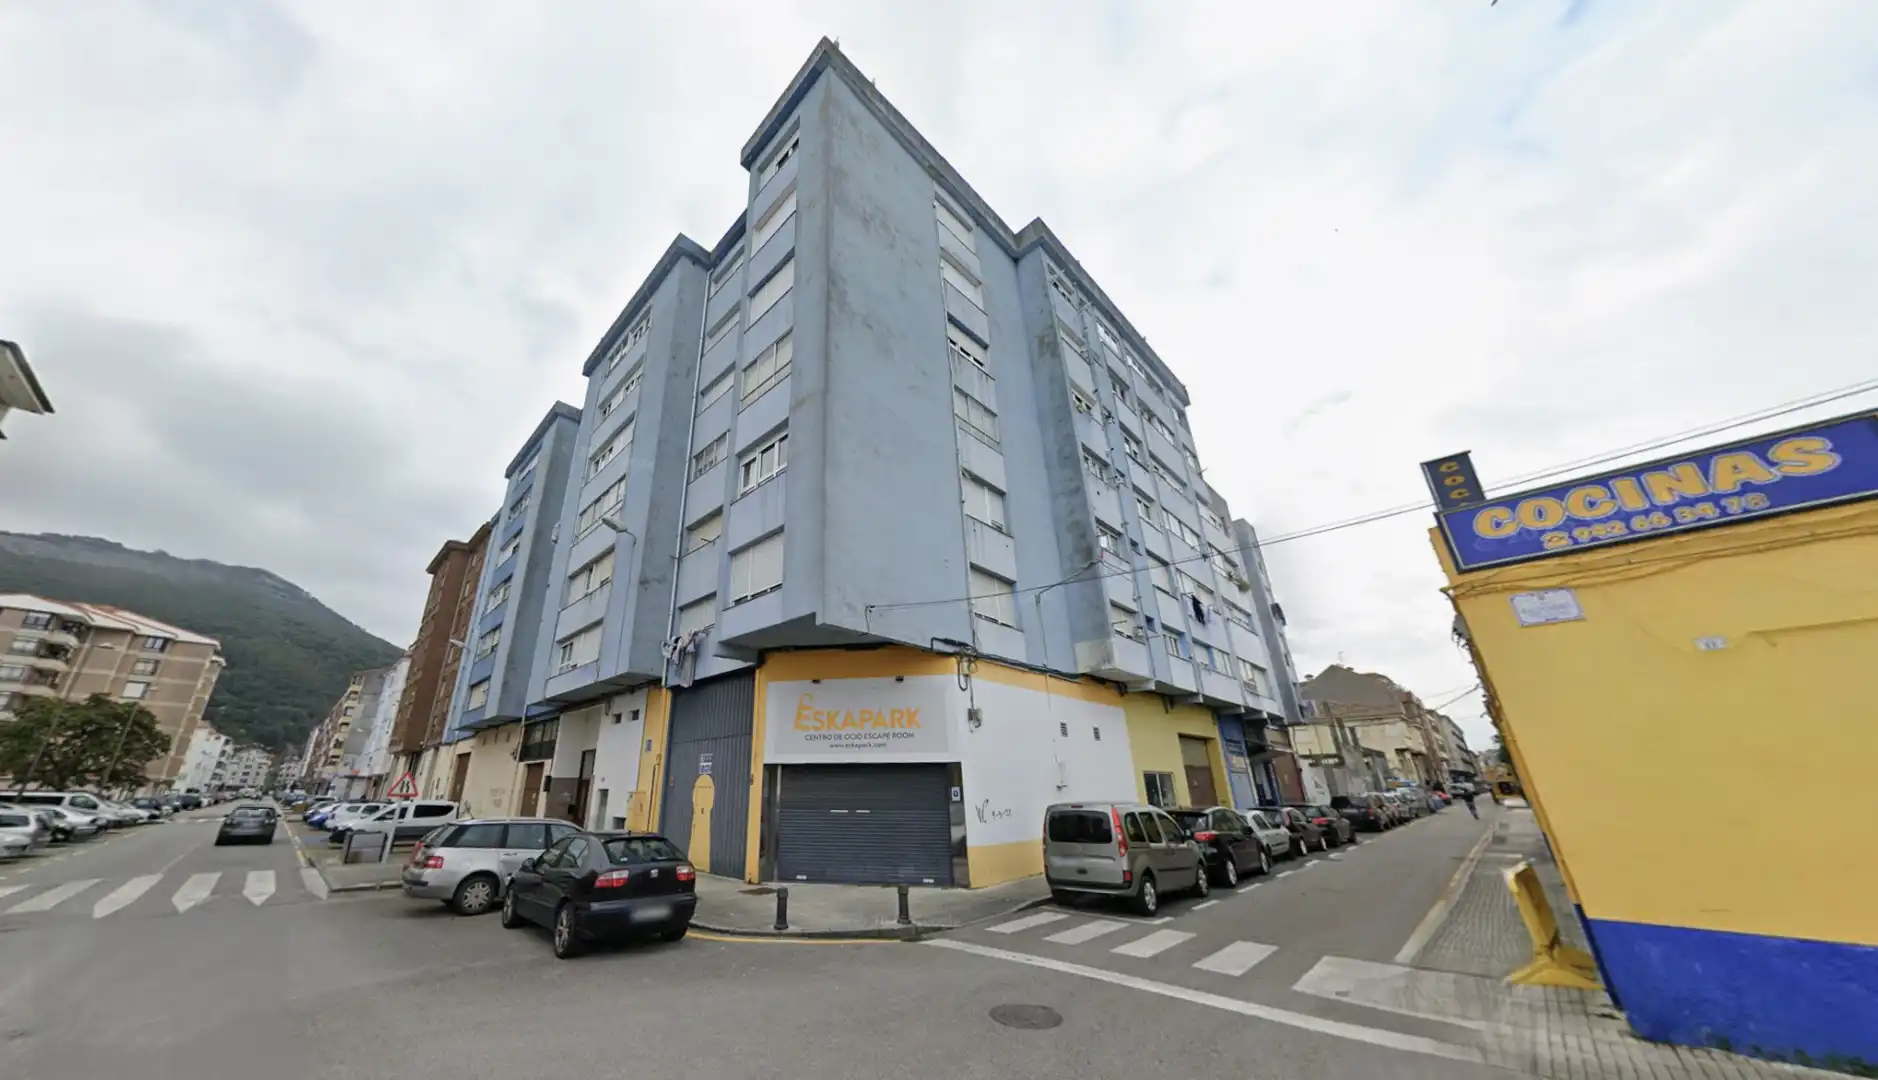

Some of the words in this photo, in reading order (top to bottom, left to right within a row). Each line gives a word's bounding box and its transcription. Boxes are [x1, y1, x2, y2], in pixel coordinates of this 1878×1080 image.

[1473, 436, 1842, 538] COCINAS
[1630, 511, 1672, 532] 66
[794, 693, 920, 731] ESKAPARK
[804, 733, 832, 741] CENTRO
[833, 733, 842, 741] DE
[843, 732, 862, 741] OCIO
[863, 731, 891, 740] ESCAPE
[892, 731, 915, 740] ROOM
